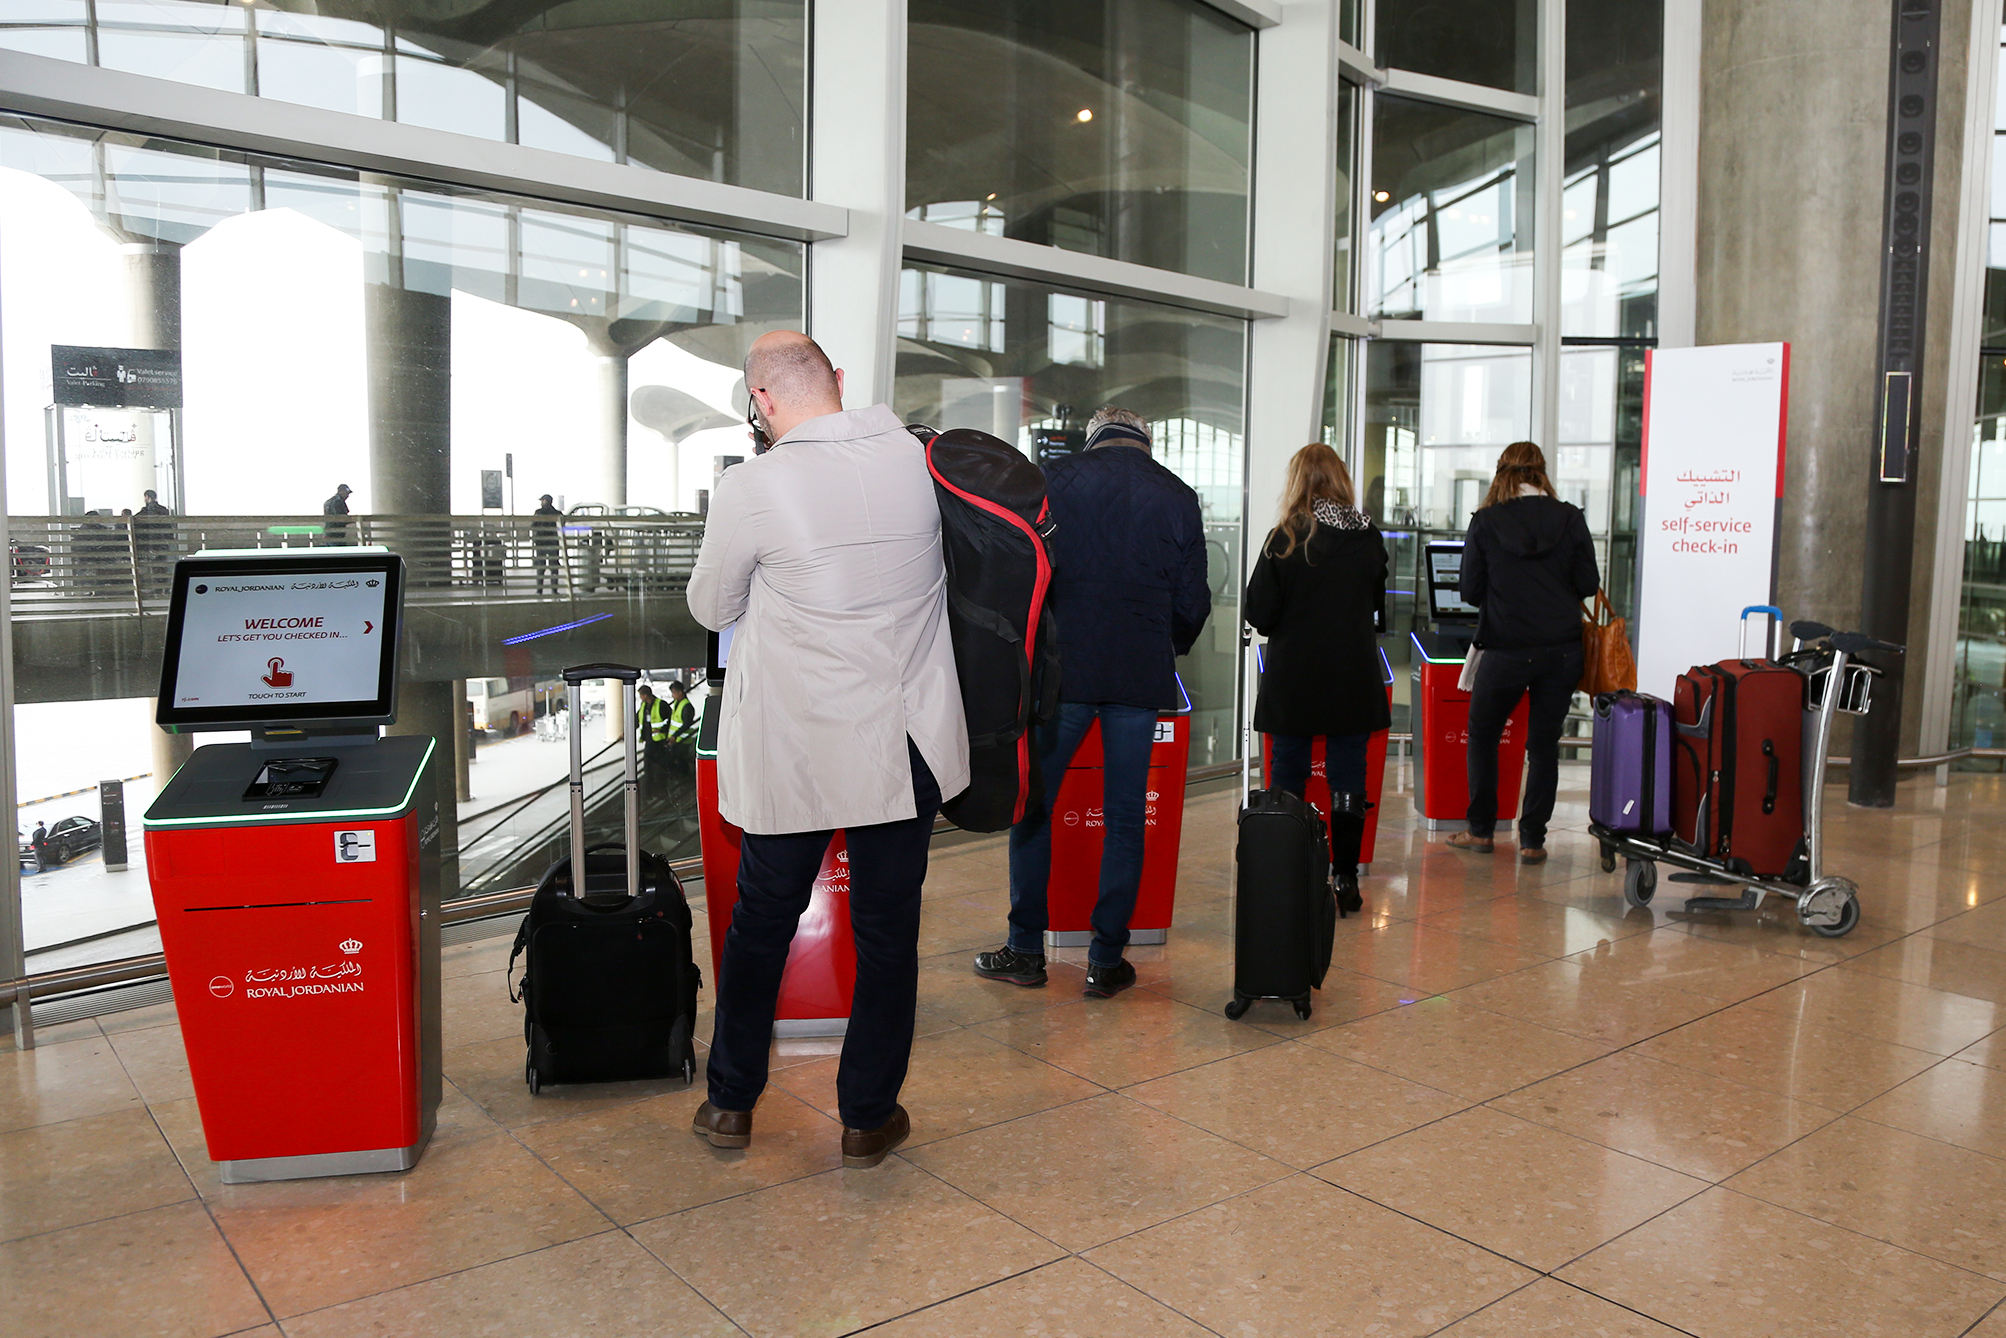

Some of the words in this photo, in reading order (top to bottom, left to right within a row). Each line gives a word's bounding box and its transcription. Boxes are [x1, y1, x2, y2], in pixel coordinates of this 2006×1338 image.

[1676, 469, 1741, 487] التشييك
[1684, 491, 1730, 512] الذاتي
[1661, 516, 1752, 534] self-service
[1672, 539, 1738, 554] check-in
[244, 616, 324, 630] WELCOME
[217, 633, 241, 642] LET'S
[242, 633, 262, 642] GET
[262, 633, 283, 641] YOU
[284, 631, 328, 641] CHECKED
[329, 631, 348, 639] IN...
[248, 692, 273, 700] TOUCH
[285, 691, 307, 699] START
